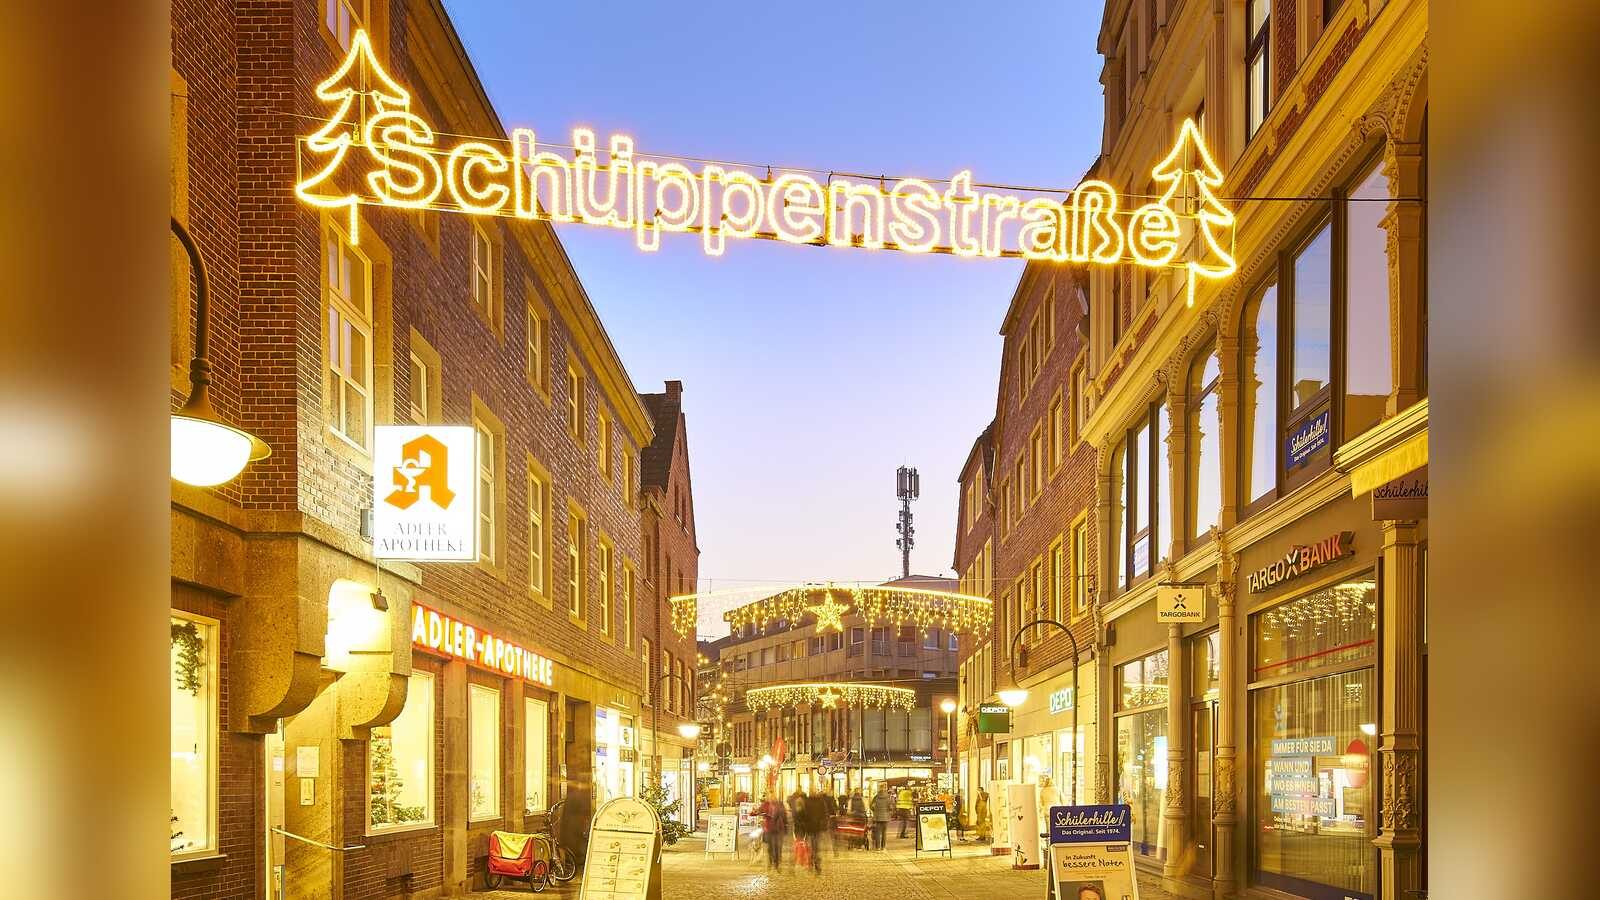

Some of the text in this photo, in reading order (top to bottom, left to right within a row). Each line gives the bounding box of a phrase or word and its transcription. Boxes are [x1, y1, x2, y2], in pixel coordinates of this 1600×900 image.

[365, 111, 1181, 266] Schüppenstraße
[393, 522, 447, 535] ADLER
[379, 538, 466, 552] APOTHEKE
[1049, 687, 1075, 712] DEPO
[1273, 739, 1332, 753] IMMER FÜR SIE DA
[1273, 760, 1310, 773] WANN UND
[1310, 800, 1333, 815] PASST
[1055, 809, 1126, 828] Schülerhilfe!
[1062, 859, 1125, 868] bessere Noten
